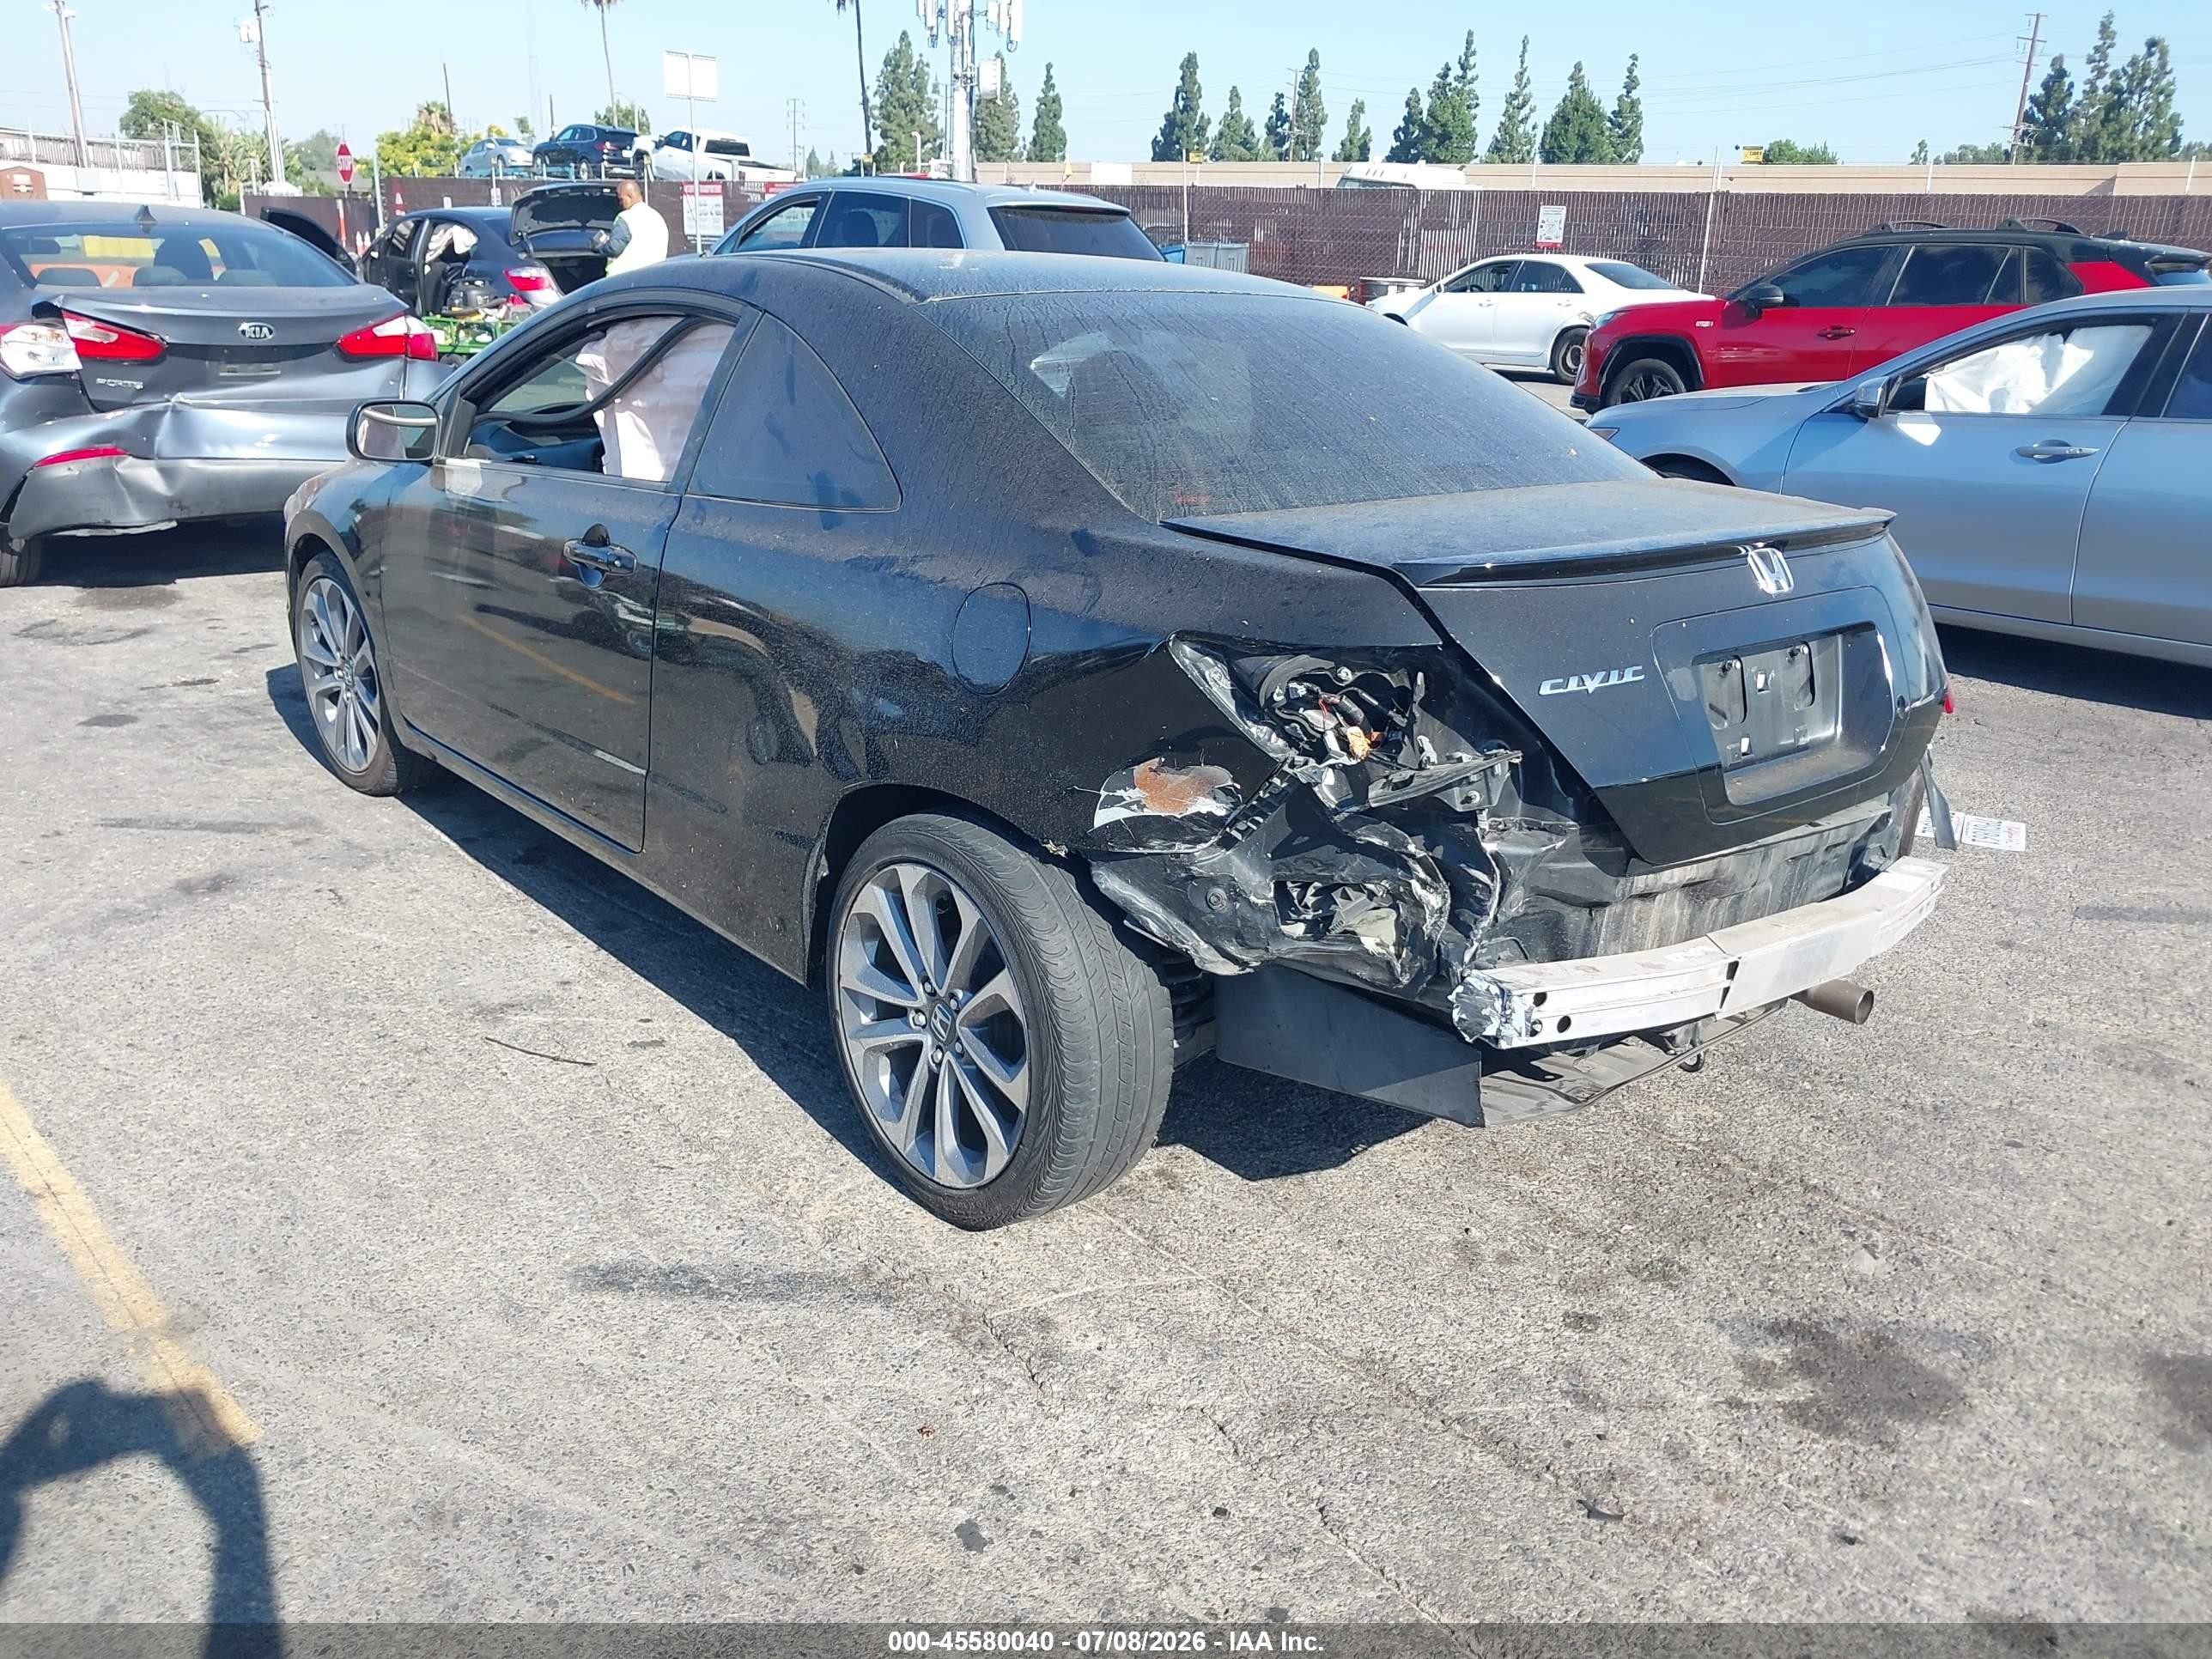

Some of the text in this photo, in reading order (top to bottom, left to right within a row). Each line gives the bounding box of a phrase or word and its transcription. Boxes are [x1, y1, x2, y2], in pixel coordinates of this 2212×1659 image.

[337, 155, 352, 171] STOP
[246, 326, 270, 337] KIA
[1538, 665, 1645, 696] CIVIC
